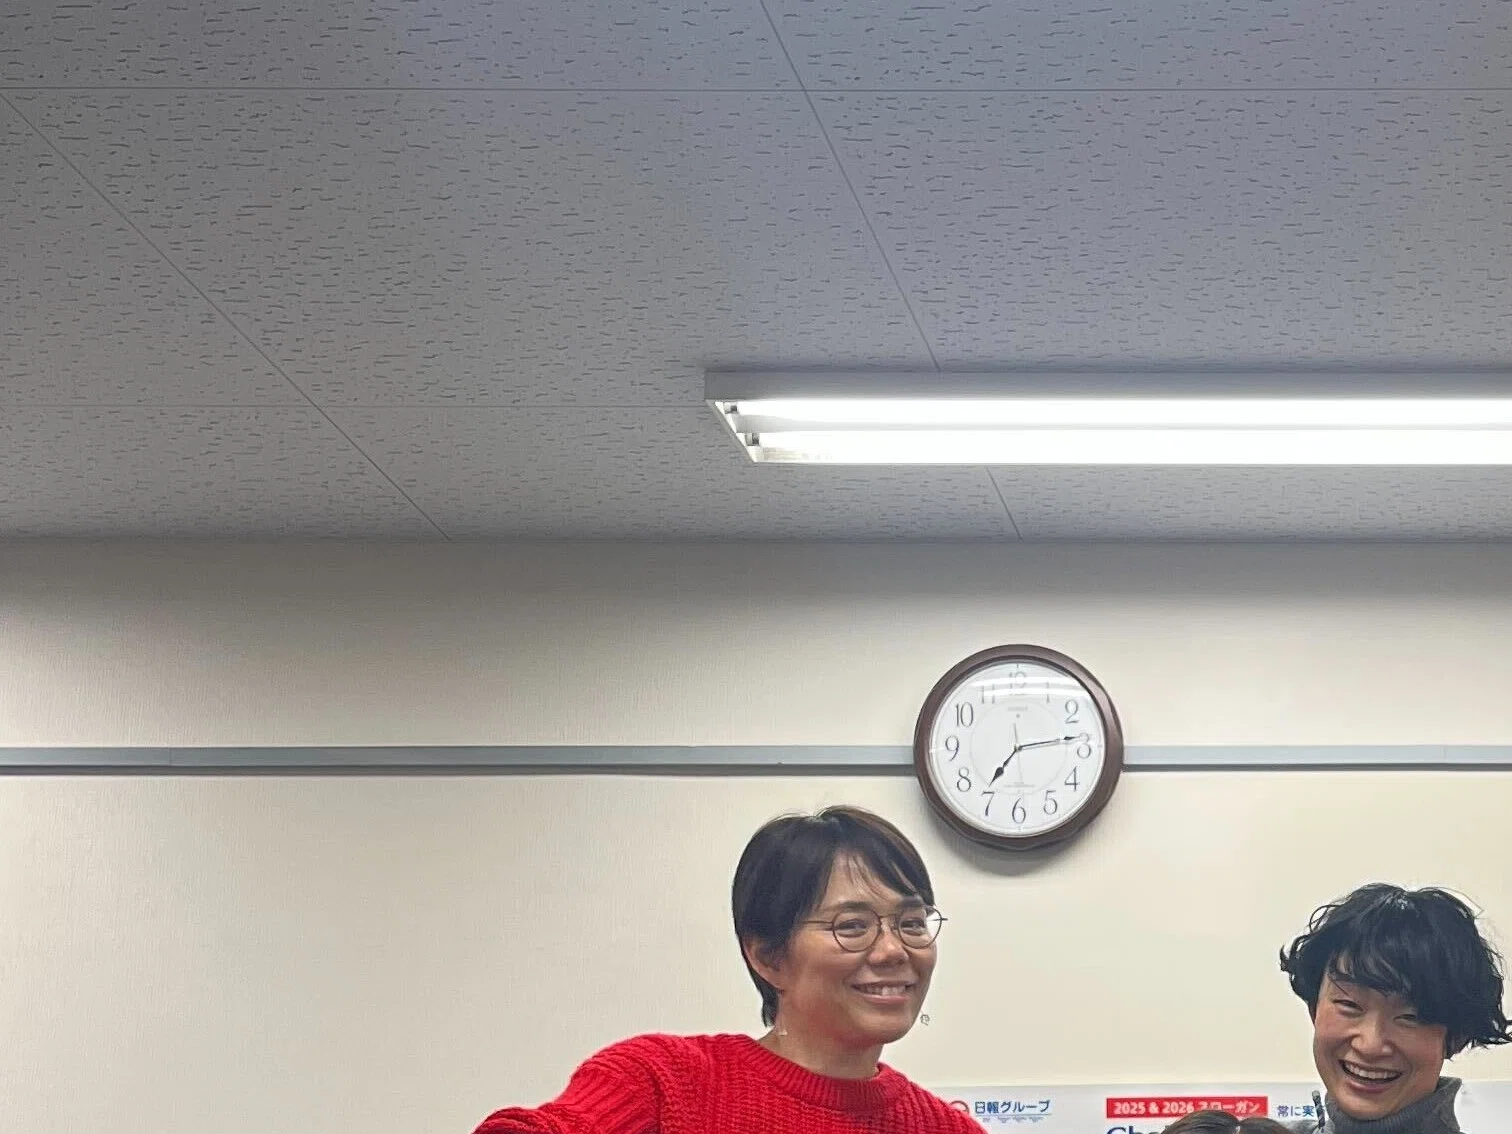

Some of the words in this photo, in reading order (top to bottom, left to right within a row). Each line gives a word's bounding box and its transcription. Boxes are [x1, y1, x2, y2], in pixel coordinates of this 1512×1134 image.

[955, 702, 974, 728] 10
[1064, 700, 1080, 724] 2
[945, 735, 960, 762] 9
[1076, 732, 1092, 759] 3
[956, 767, 972, 792] 8
[1064, 766, 1080, 792] 4
[981, 791, 995, 817] 7
[1011, 798, 1026, 825] 6
[1043, 789, 1058, 815] 5
[975, 1100, 1051, 1114] 日報グループ
[1113, 1101, 1146, 1115] 2025
[1149, 1101, 1160, 1114] &
[1164, 1100, 1195, 1114] 2026
[1277, 1104, 1315, 1118] 常に実
